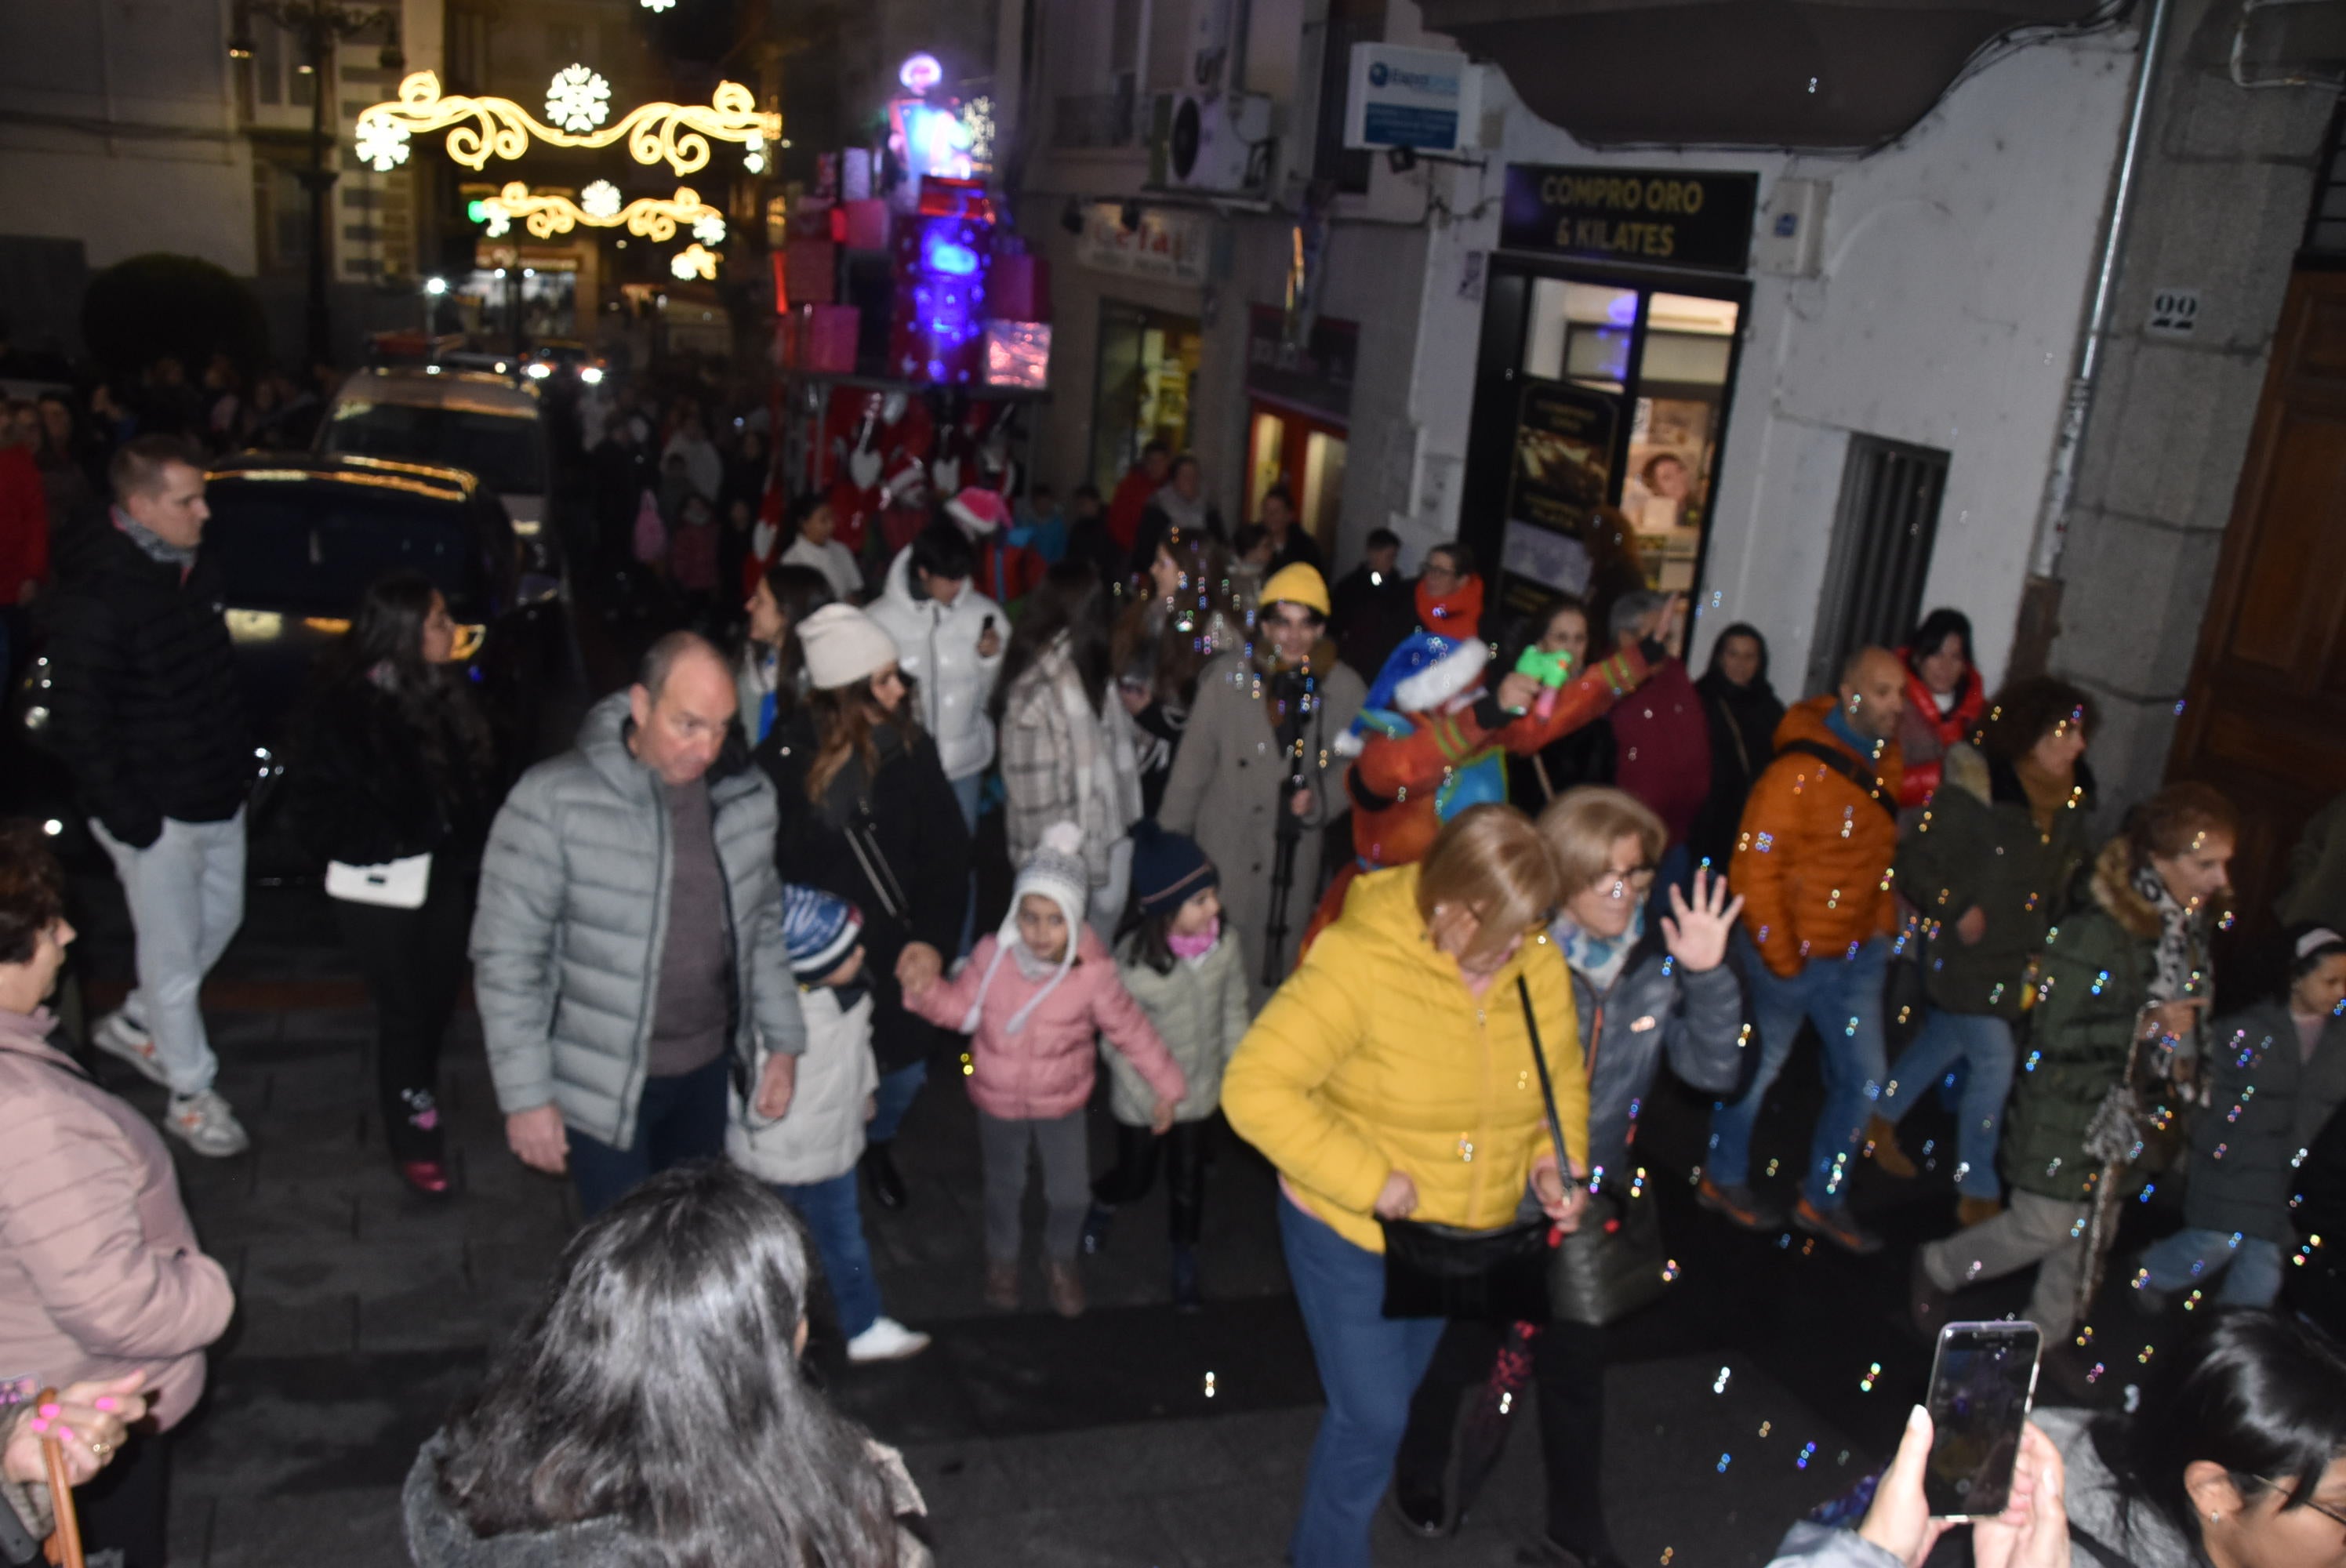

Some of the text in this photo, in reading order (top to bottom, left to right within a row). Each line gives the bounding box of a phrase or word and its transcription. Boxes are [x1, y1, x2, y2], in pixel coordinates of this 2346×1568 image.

[1542, 175, 1703, 214] COMPRO ORO
[1576, 220, 1675, 256] KILATES
